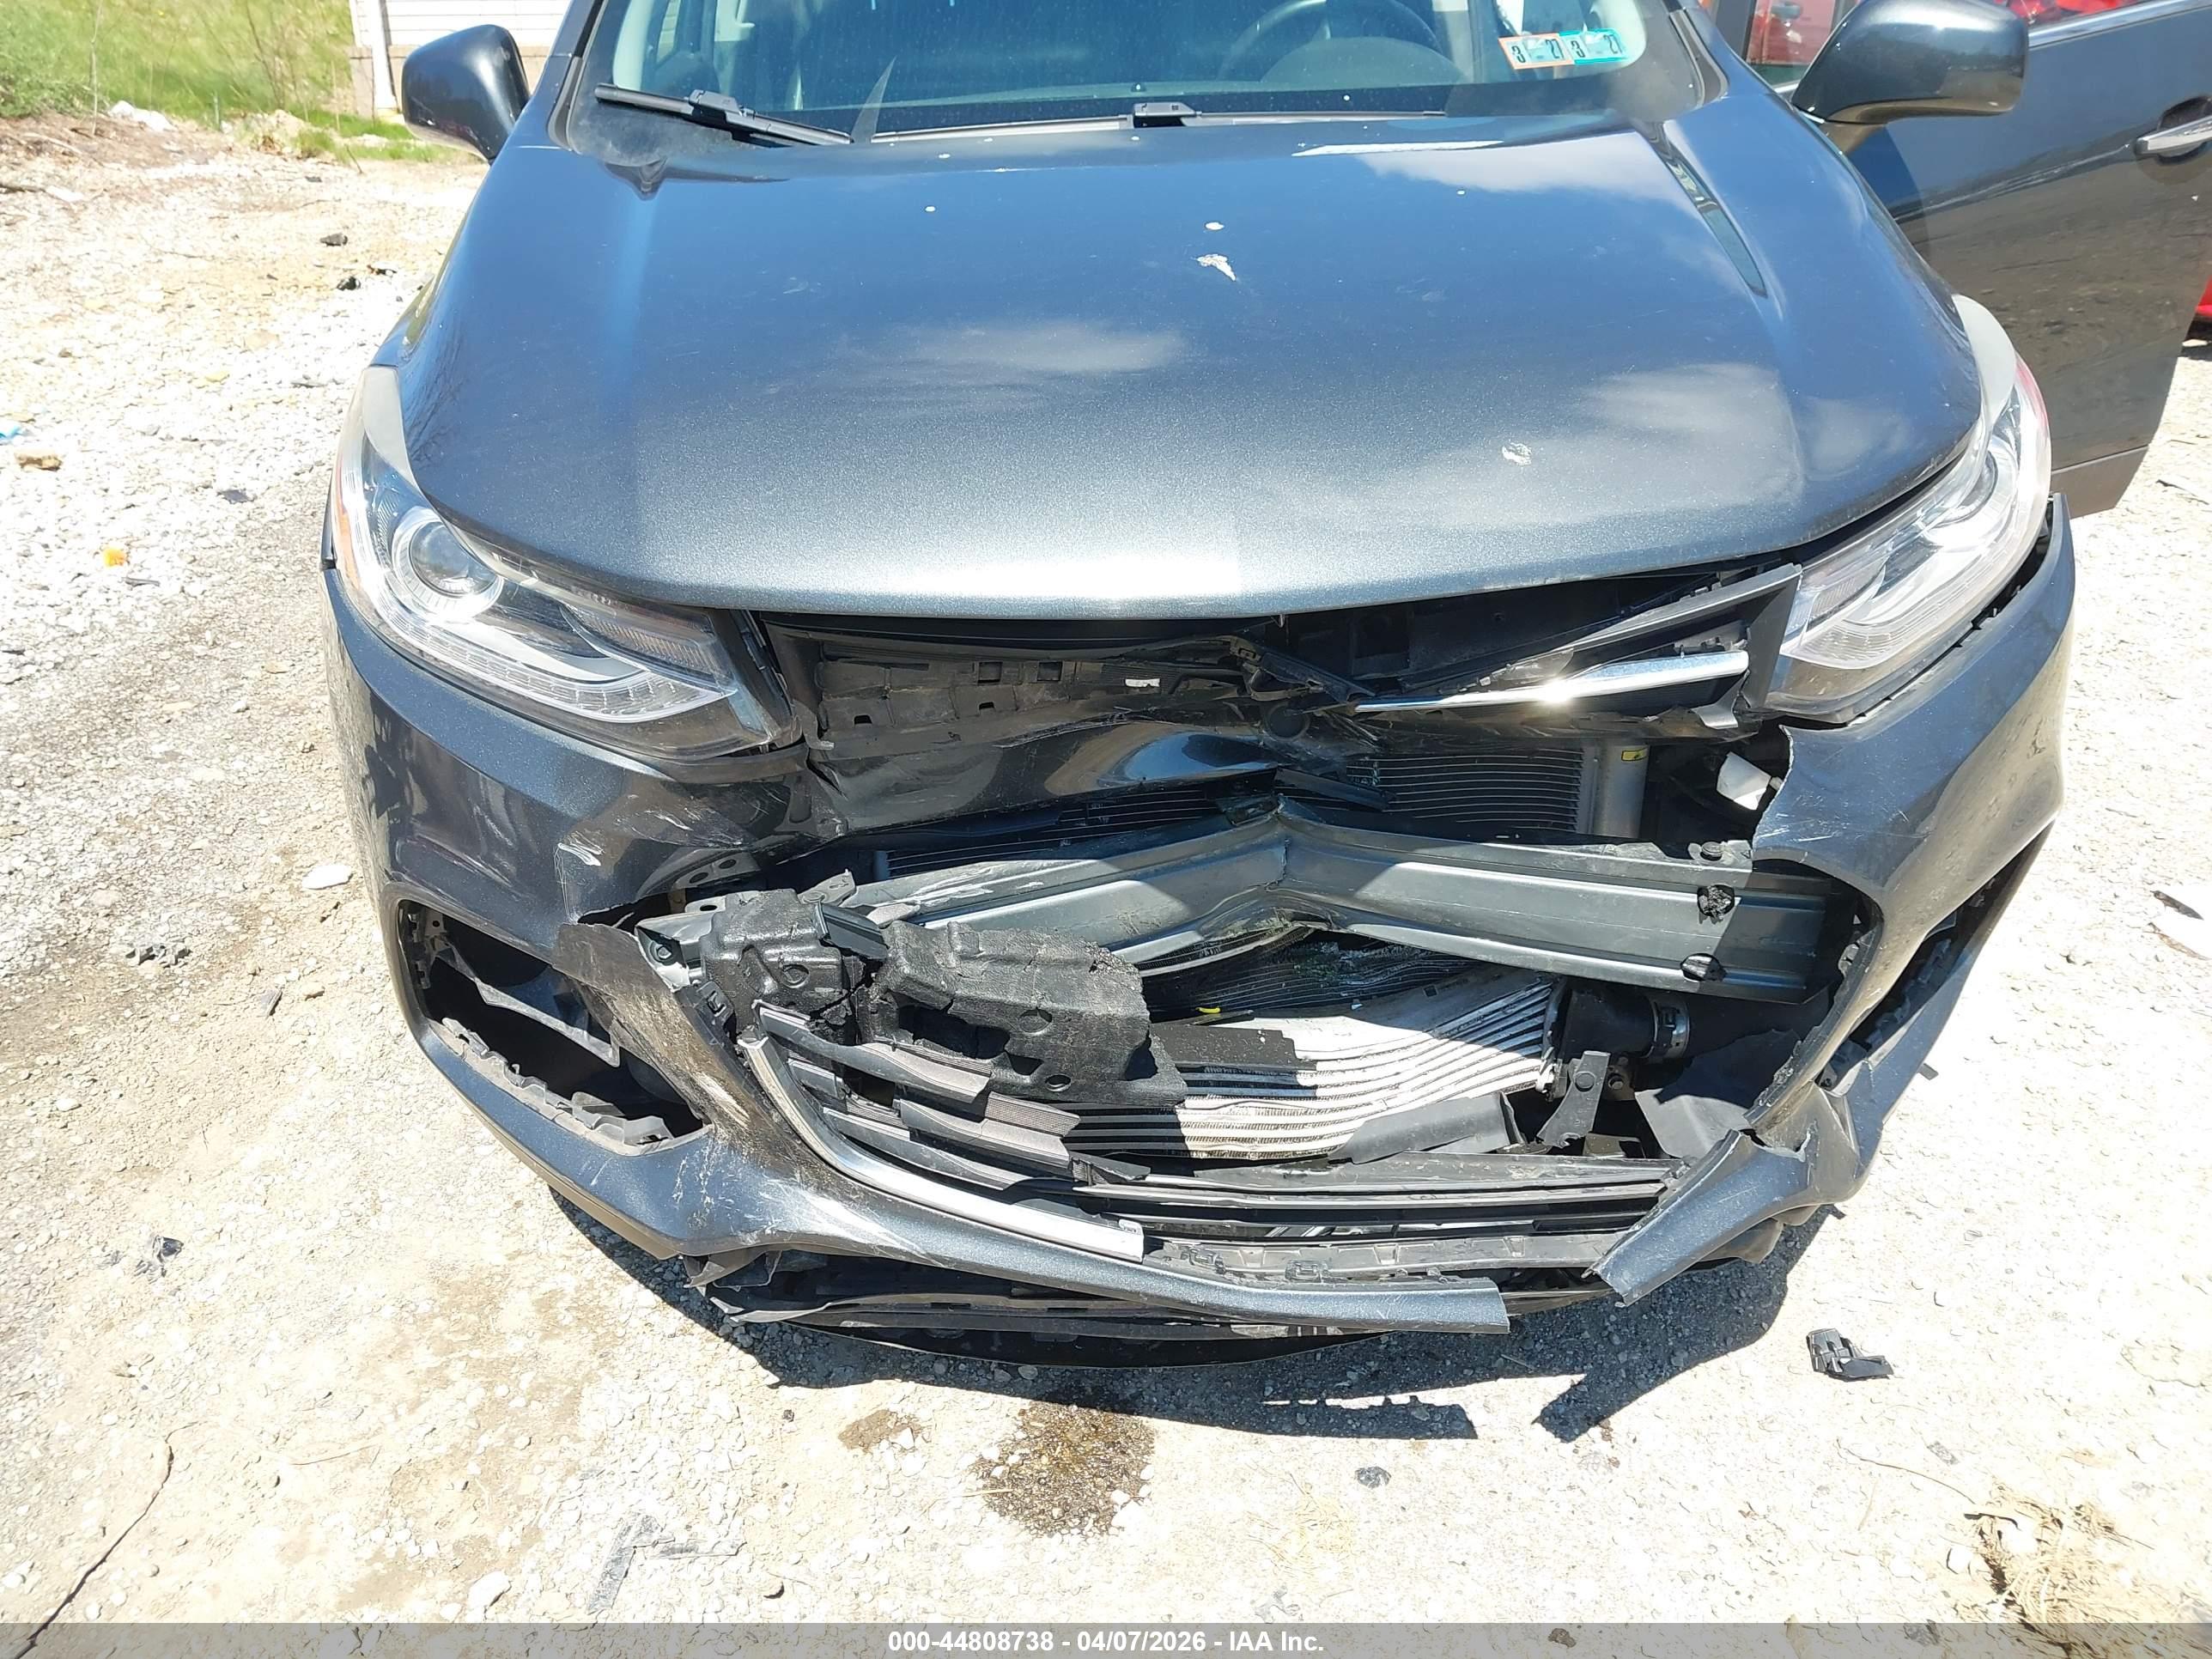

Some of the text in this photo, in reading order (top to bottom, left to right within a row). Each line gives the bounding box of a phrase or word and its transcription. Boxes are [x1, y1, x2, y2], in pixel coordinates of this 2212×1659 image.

[1511, 39, 1565, 64] 3 27
[1571, 34, 1622, 58] 3 27
